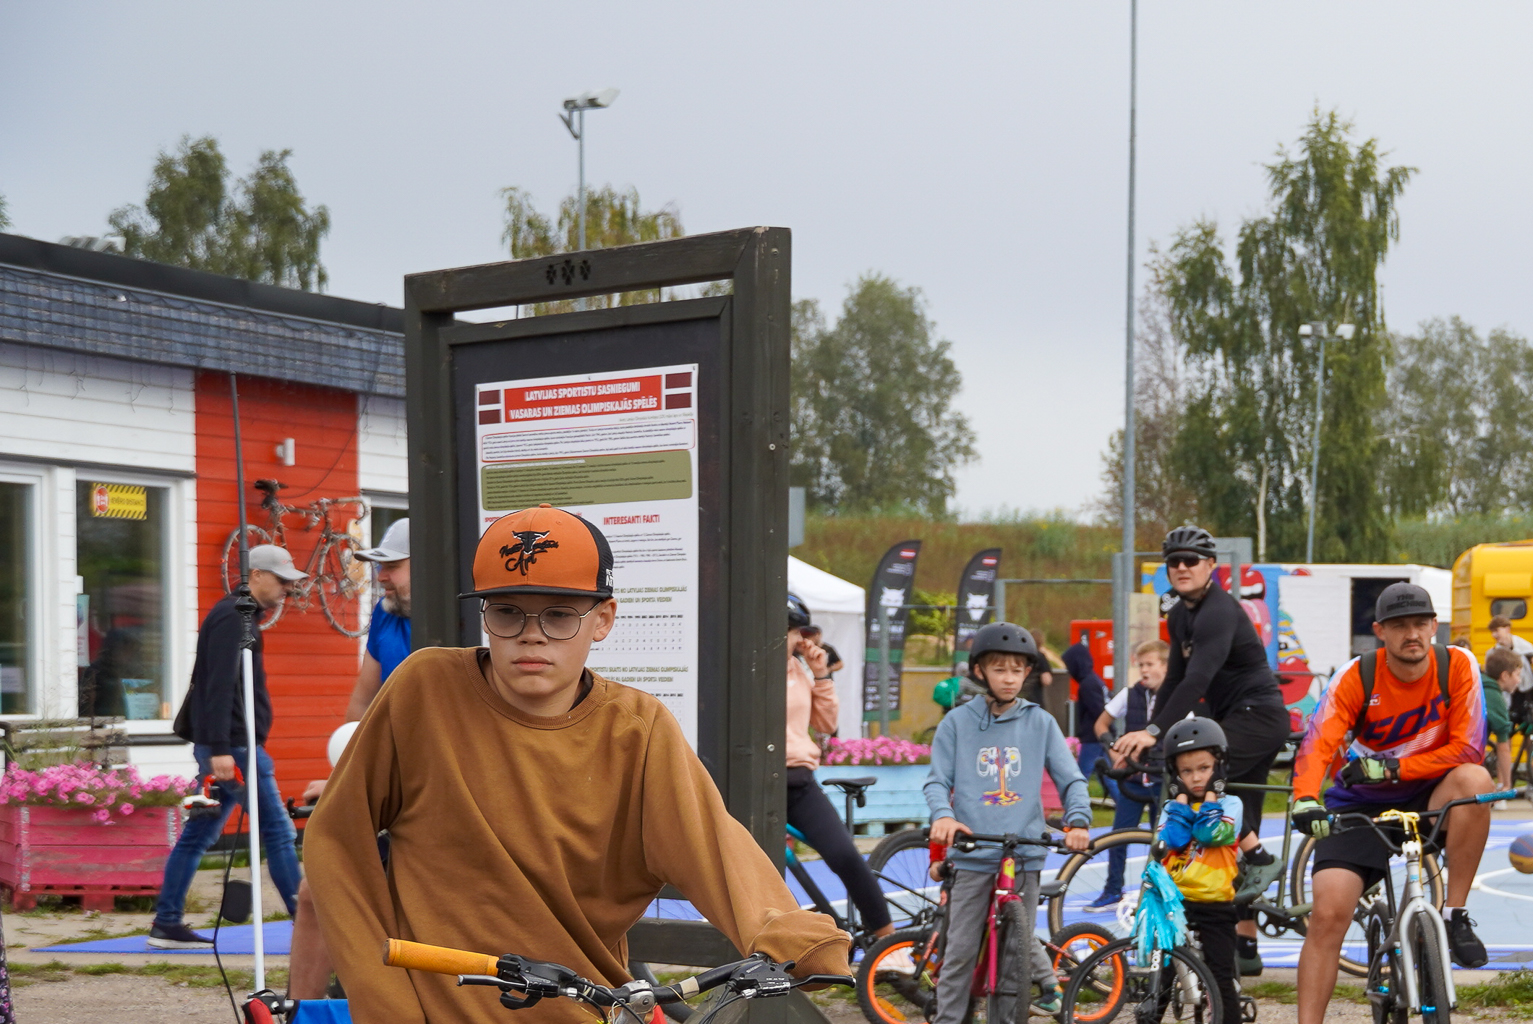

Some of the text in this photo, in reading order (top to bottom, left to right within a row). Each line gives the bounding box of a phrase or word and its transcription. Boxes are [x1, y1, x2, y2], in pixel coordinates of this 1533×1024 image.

[525, 381, 641, 402] LATVIJAS SPORTISTU SASNIEGUMI
[509, 396, 658, 420] VASARAS UN ZIEMAS OLIMPISKAJĀS SPĒLĒS
[603, 514, 661, 526] INTERESANTI FAKTI
[1362, 692, 1446, 746] FOX
